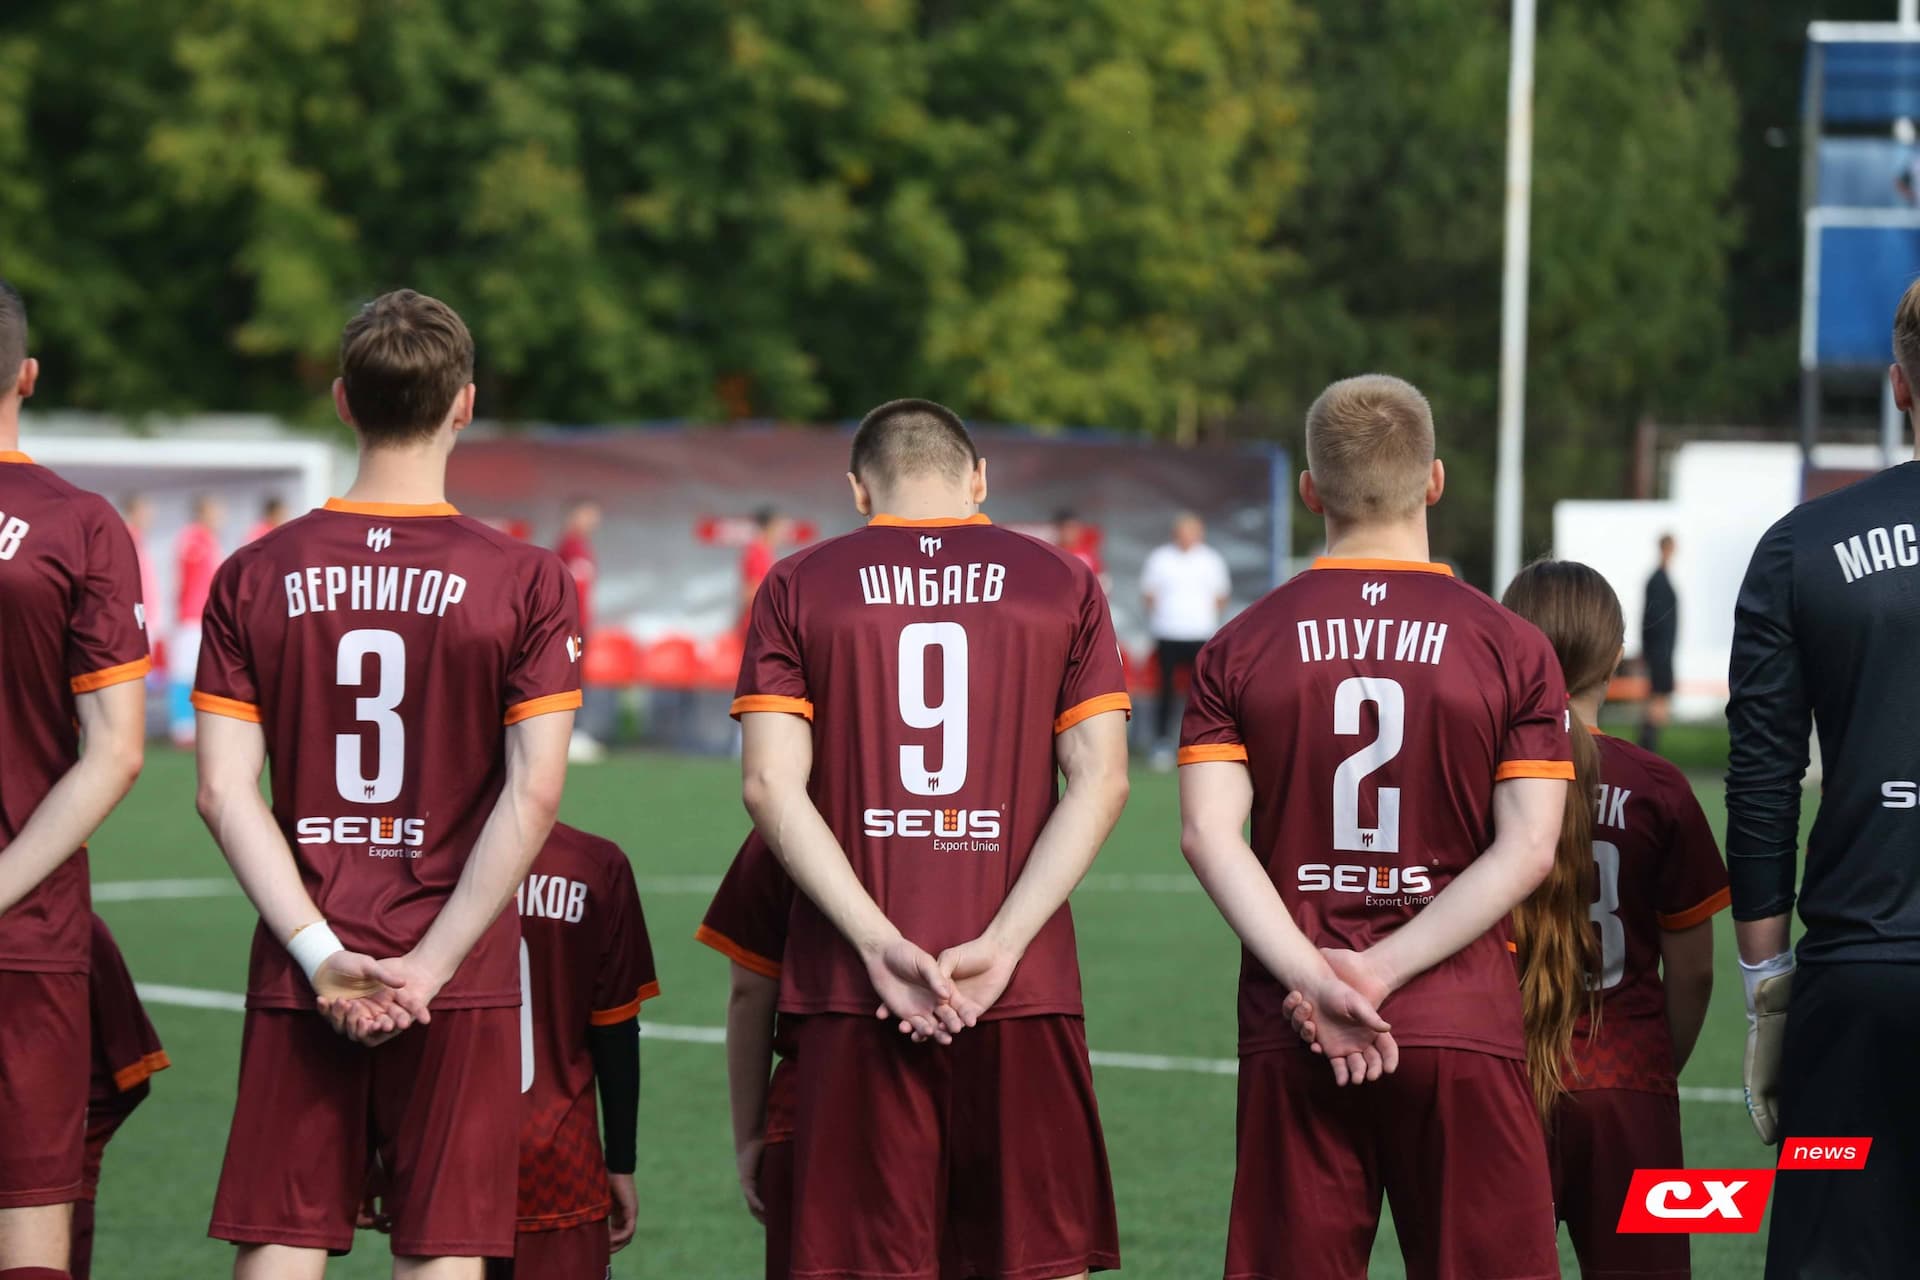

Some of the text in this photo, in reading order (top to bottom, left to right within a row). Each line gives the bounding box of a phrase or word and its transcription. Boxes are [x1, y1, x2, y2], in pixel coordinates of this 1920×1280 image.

[0, 511, 30, 560] В
[1833, 524, 1919, 584] МАС
[284, 565, 467, 618] ВЕРНИГОР
[859, 563, 1006, 607] ШИБАЕВ
[1297, 618, 1448, 665] ПЛУГИН
[336, 629, 406, 803] 3
[899, 622, 968, 796] 9
[1333, 677, 1405, 853] 2
[1881, 781, 1920, 808] S
[297, 817, 425, 846] SEUS
[864, 808, 1000, 838] SEUS
[368, 845, 404, 859] Export
[933, 839, 1000, 852] Export Union
[1297, 863, 1432, 895] SEUS
[1365, 895, 1402, 907] Export
